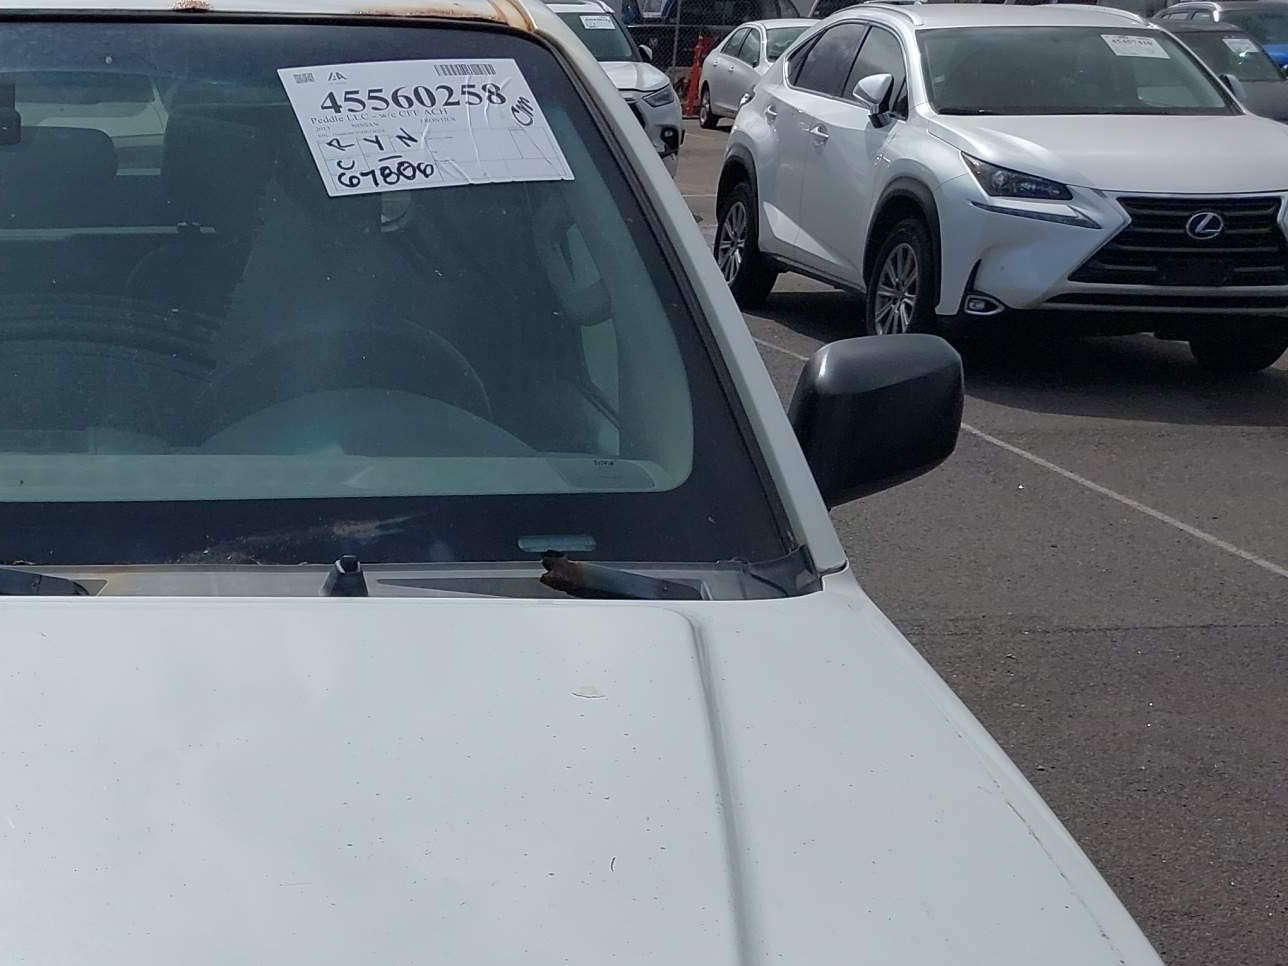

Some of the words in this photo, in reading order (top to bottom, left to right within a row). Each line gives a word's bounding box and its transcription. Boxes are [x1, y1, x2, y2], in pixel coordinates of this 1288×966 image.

[320, 82, 507, 114] 45560258
[310, 115, 344, 125] Peddle
[346, 112, 369, 121] LLC
